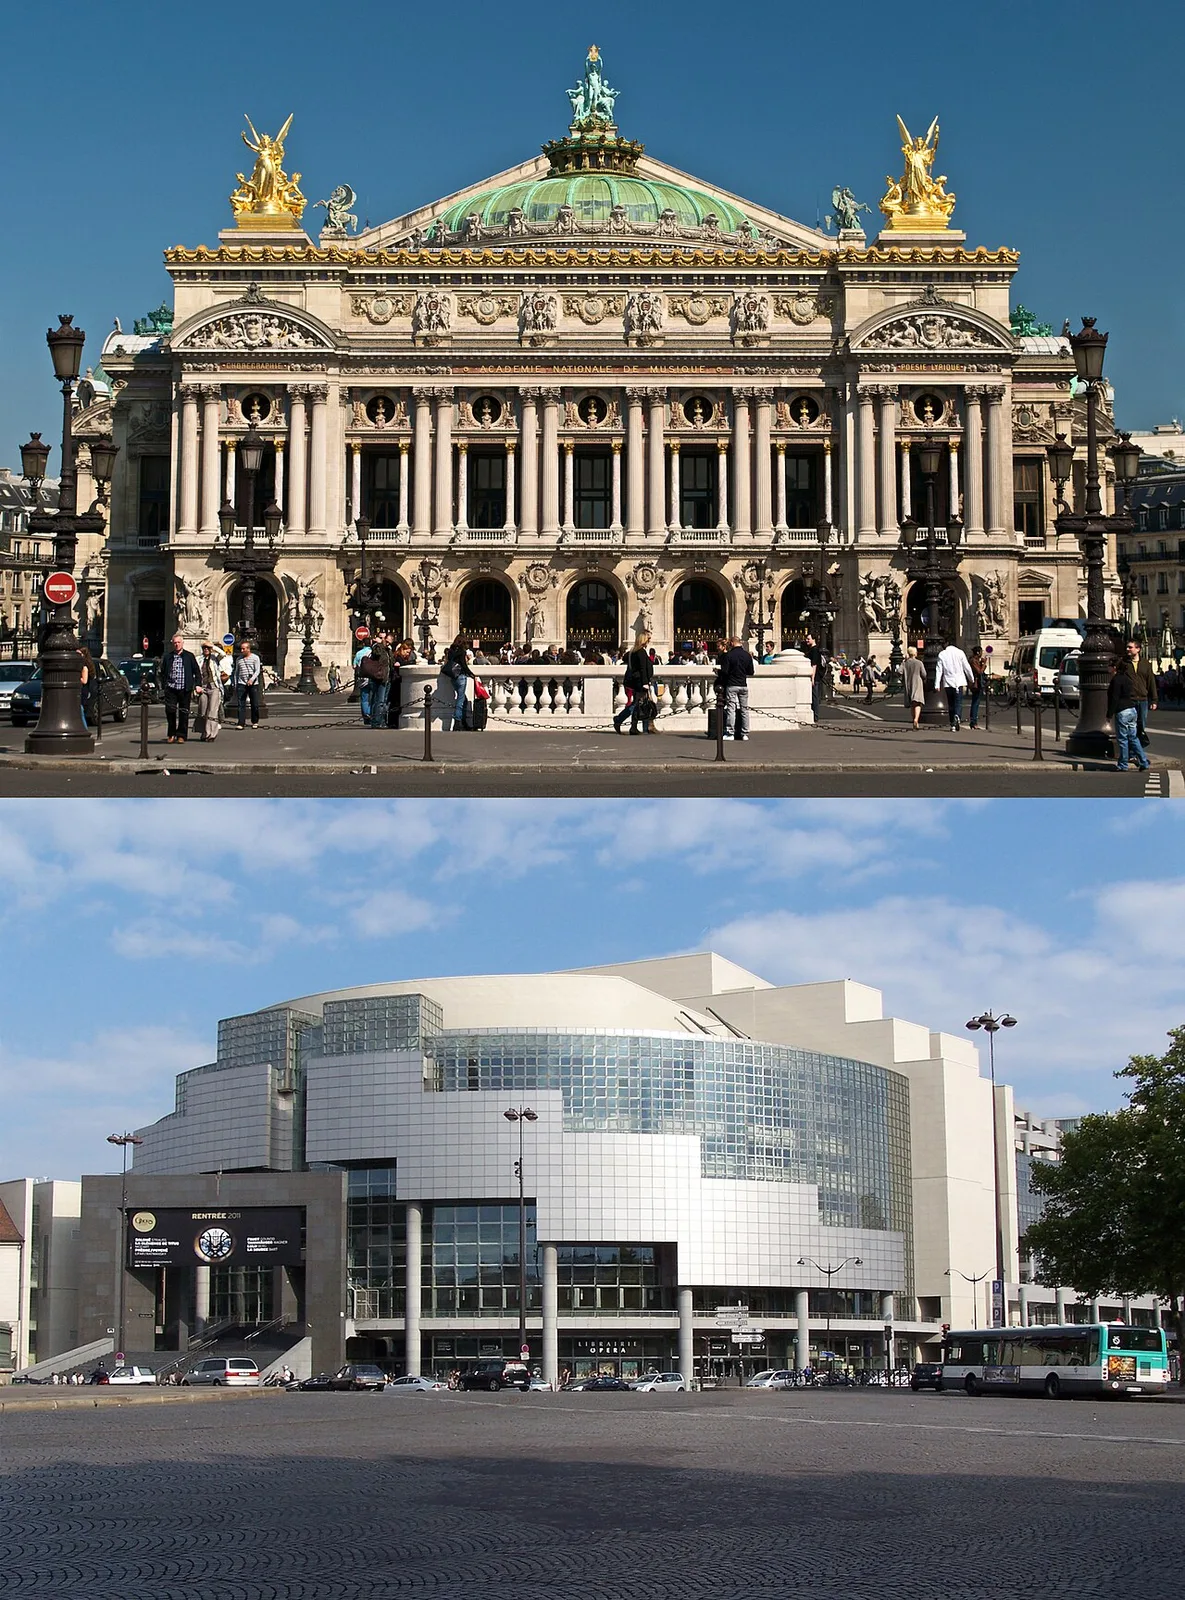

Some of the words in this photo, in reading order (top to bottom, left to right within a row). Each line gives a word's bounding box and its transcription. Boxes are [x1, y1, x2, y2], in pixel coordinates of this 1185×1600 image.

[479, 365, 541, 373] ACADEMIE
[552, 365, 612, 373] NATIONALE
[623, 365, 639, 373] DE
[650, 365, 706, 373] MUSIQUE
[900, 363, 927, 371] POESIE
[931, 363, 961, 371] LYRIQUE
